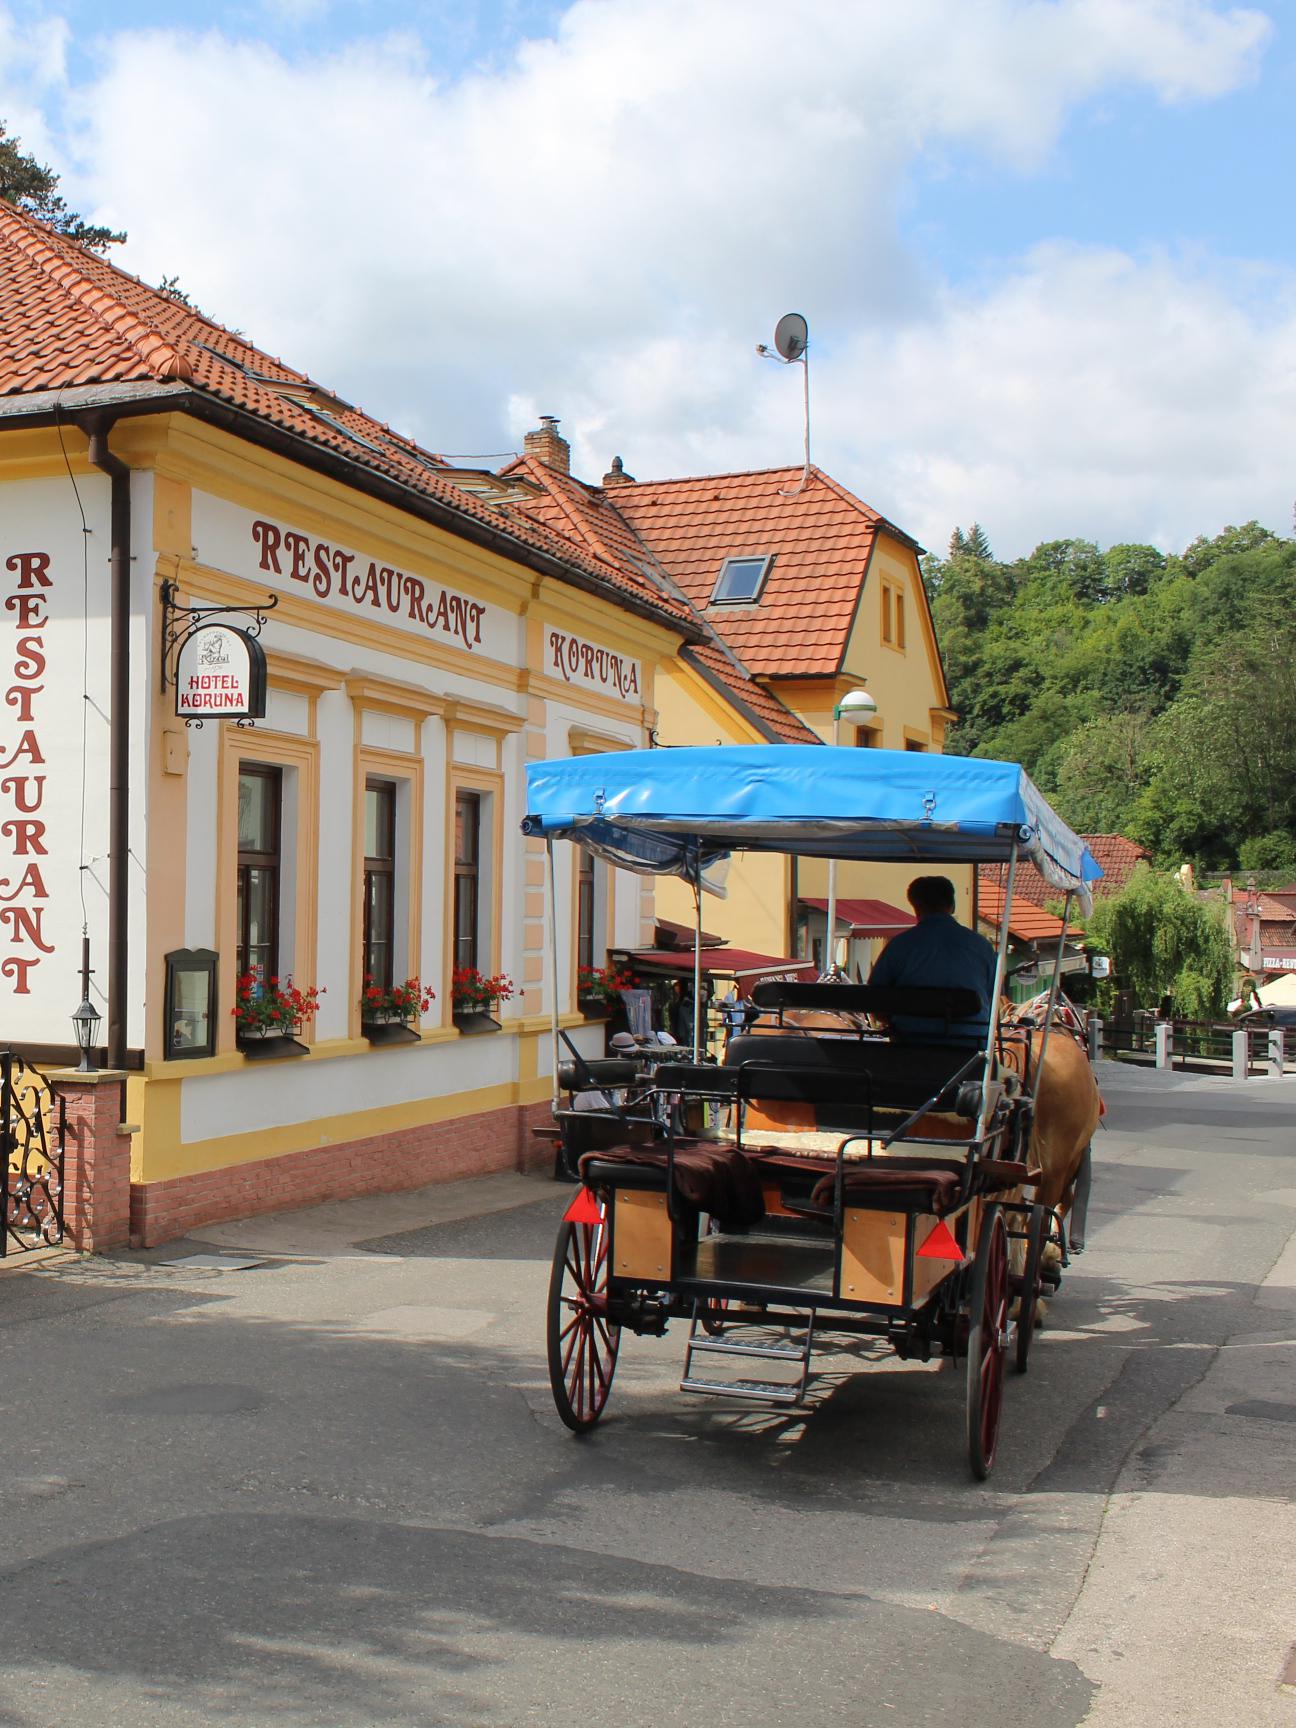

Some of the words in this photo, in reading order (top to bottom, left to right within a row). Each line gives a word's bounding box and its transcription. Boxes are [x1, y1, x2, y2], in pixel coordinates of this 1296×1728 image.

[252, 520, 486, 650] RESTAURANT
[188, 675, 239, 690] HOTEL
[550, 632, 638, 699] KORUNA
[181, 692, 245, 709] KORUNA
